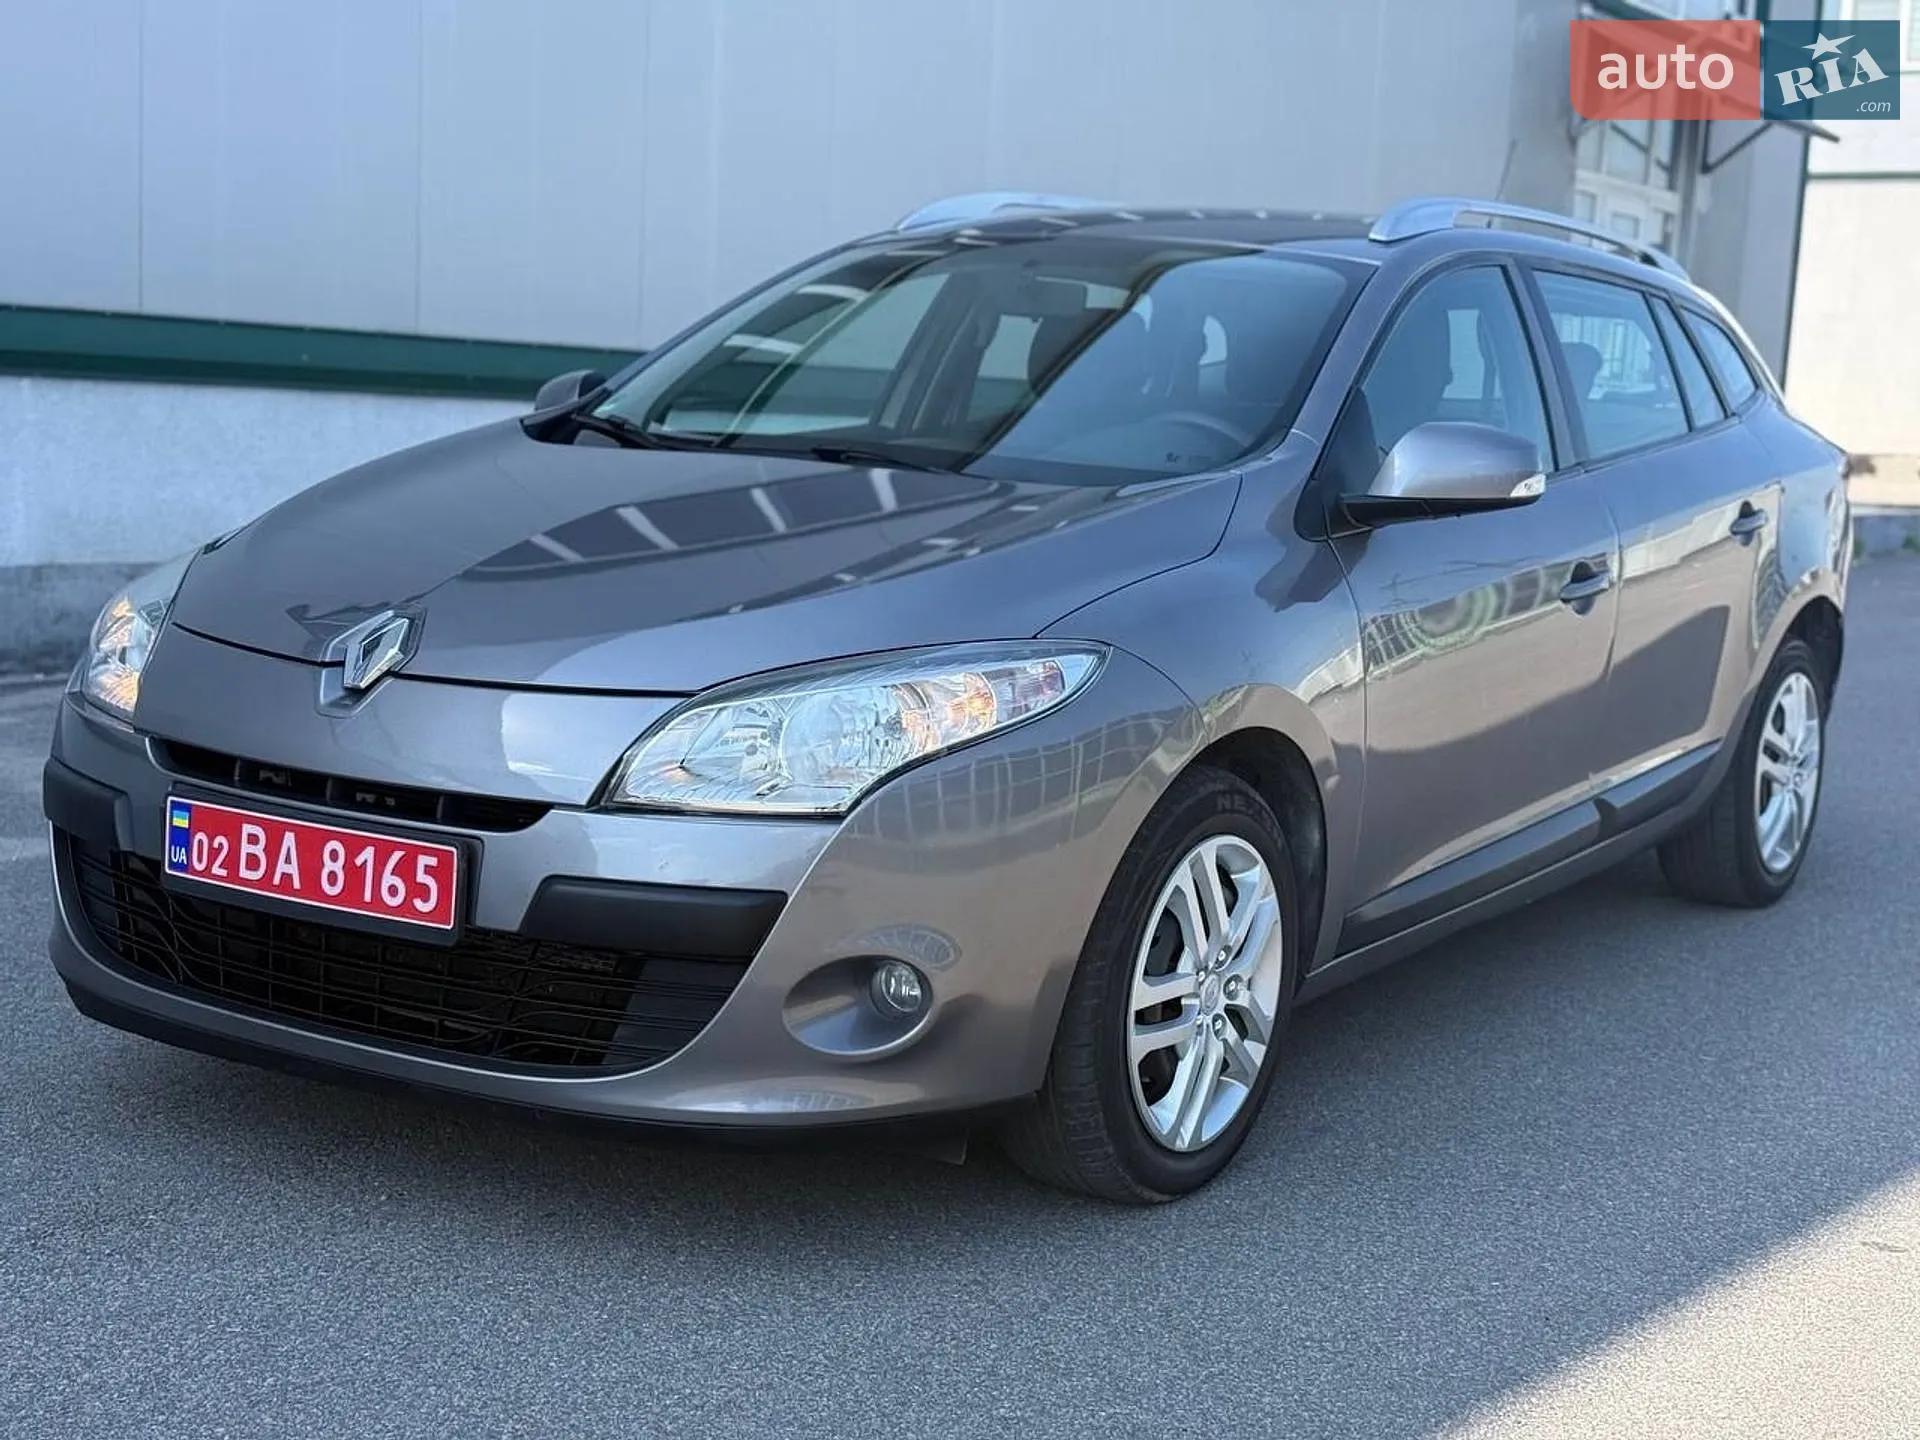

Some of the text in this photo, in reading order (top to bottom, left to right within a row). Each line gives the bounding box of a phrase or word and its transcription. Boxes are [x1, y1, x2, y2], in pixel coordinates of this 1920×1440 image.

[170, 845, 188, 865] UA
[191, 823, 438, 913] 02 BA 8165
